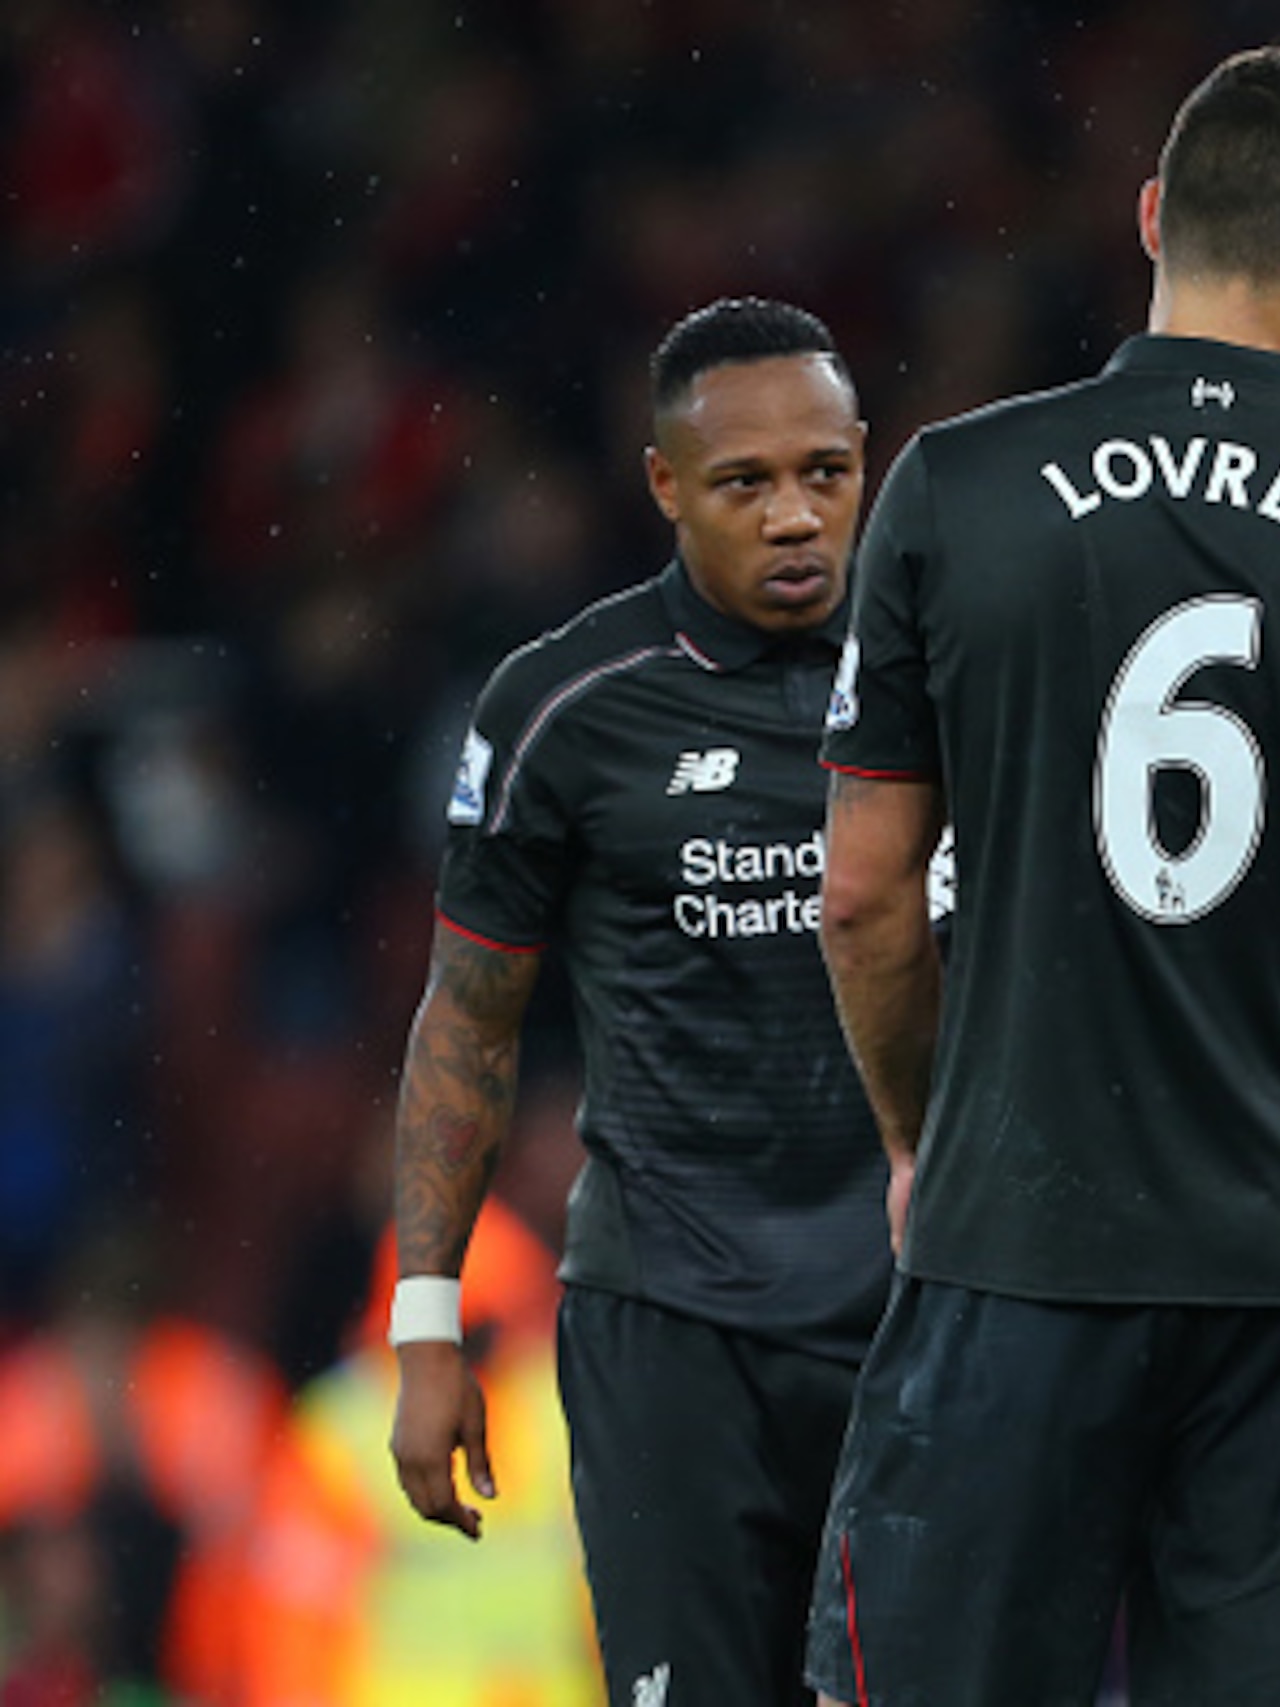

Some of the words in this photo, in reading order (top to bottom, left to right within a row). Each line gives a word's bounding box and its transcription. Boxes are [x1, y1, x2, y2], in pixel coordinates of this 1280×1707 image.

[1092, 592, 1267, 925] 6
[682, 830, 827, 887] Stand
[674, 889, 823, 938] Charte
